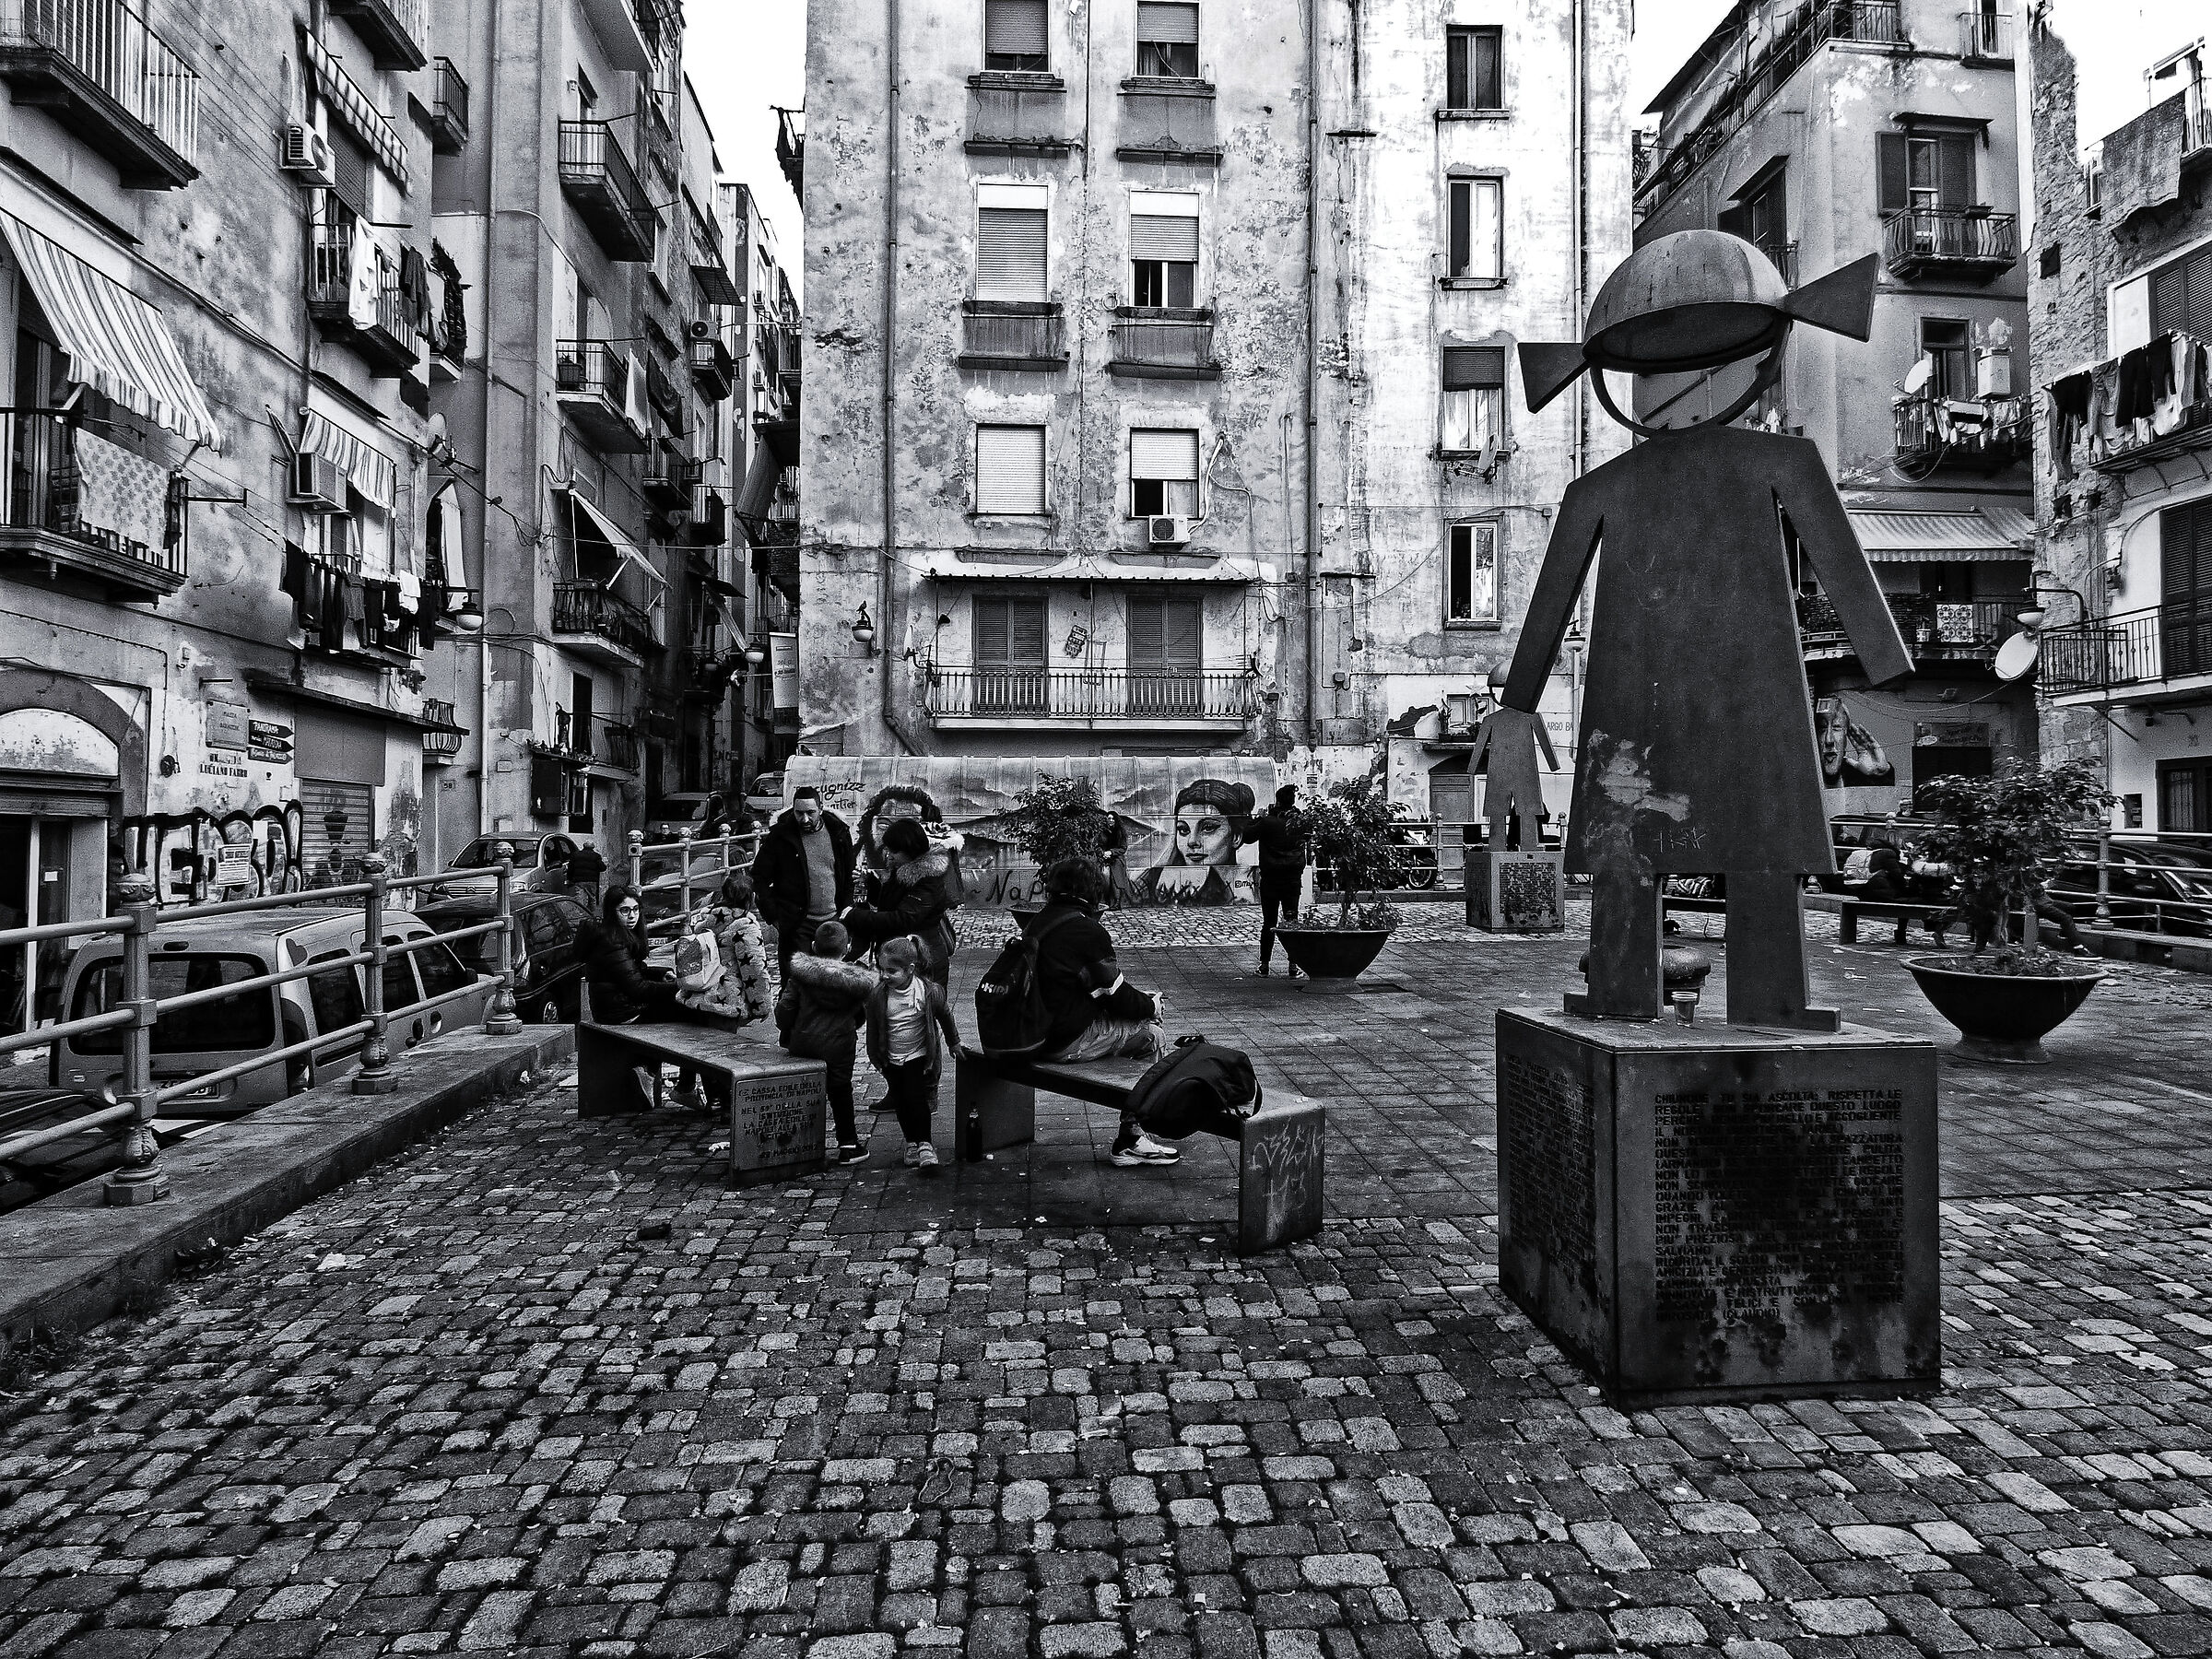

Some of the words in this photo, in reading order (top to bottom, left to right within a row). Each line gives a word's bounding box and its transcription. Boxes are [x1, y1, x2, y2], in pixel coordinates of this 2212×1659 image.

[1547, 722, 1563, 731] ARGO
[1828, 1090, 1884, 1100] RISPETTA
[1888, 1089, 1902, 1100] LE
[741, 1107, 757, 1115] NEL
[1655, 1137, 1678, 1147] NON
[1655, 1170, 1678, 1180] NON
[1655, 1181, 1679, 1191] NON
[1655, 1191, 1703, 1201] QUANDO
[1655, 1202, 1698, 1212] GRAZIE
[1655, 1224, 1679, 1234] NON
